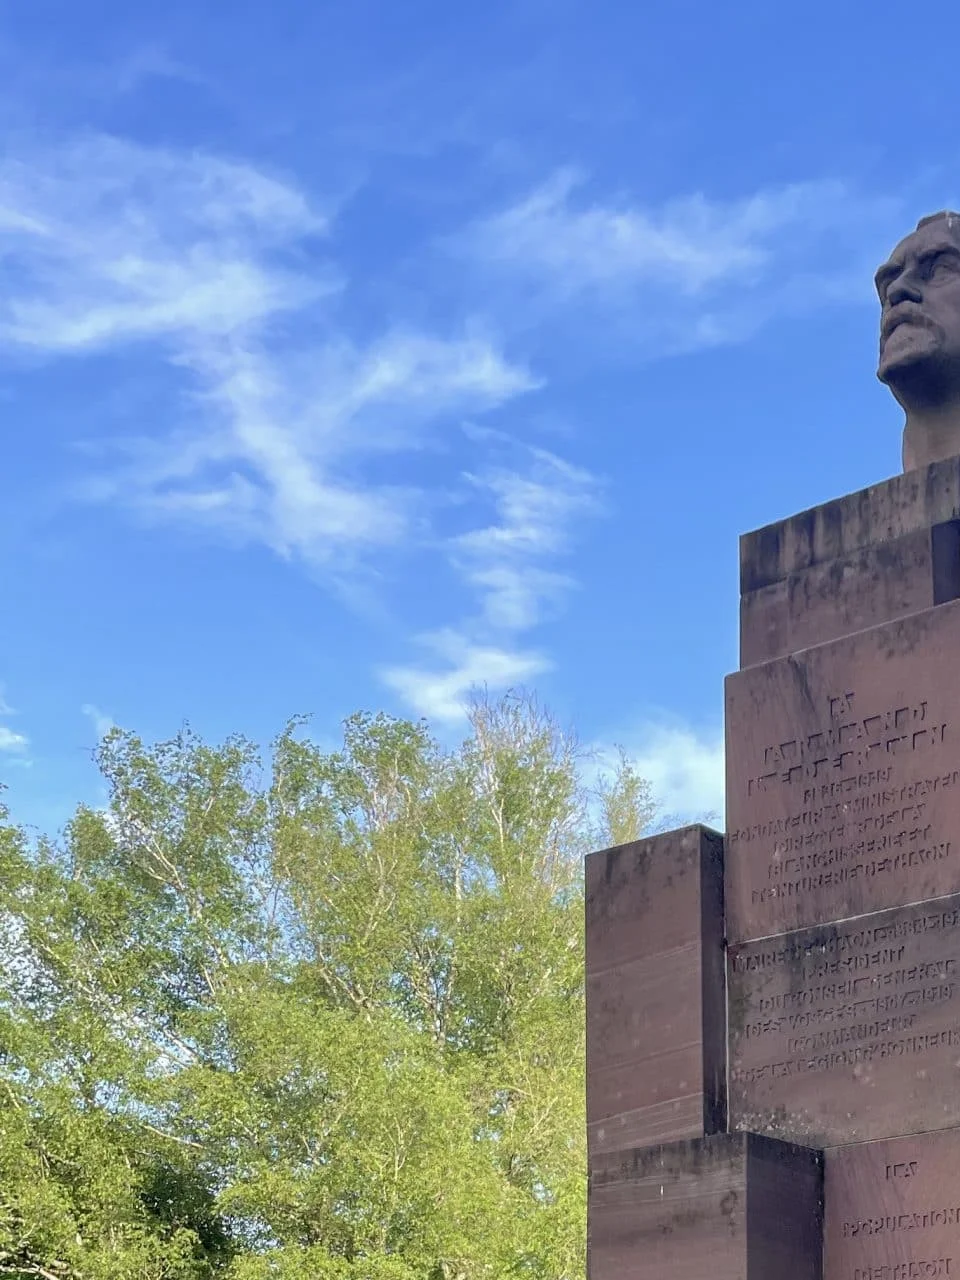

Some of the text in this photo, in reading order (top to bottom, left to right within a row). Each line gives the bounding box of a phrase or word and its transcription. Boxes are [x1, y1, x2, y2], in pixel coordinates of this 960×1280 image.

[763, 700, 928, 764] ARMAND
[747, 723, 948, 797] LEDERLIN
[885, 1161, 917, 1180] LA
[888, 1258, 953, 1280] THAON
